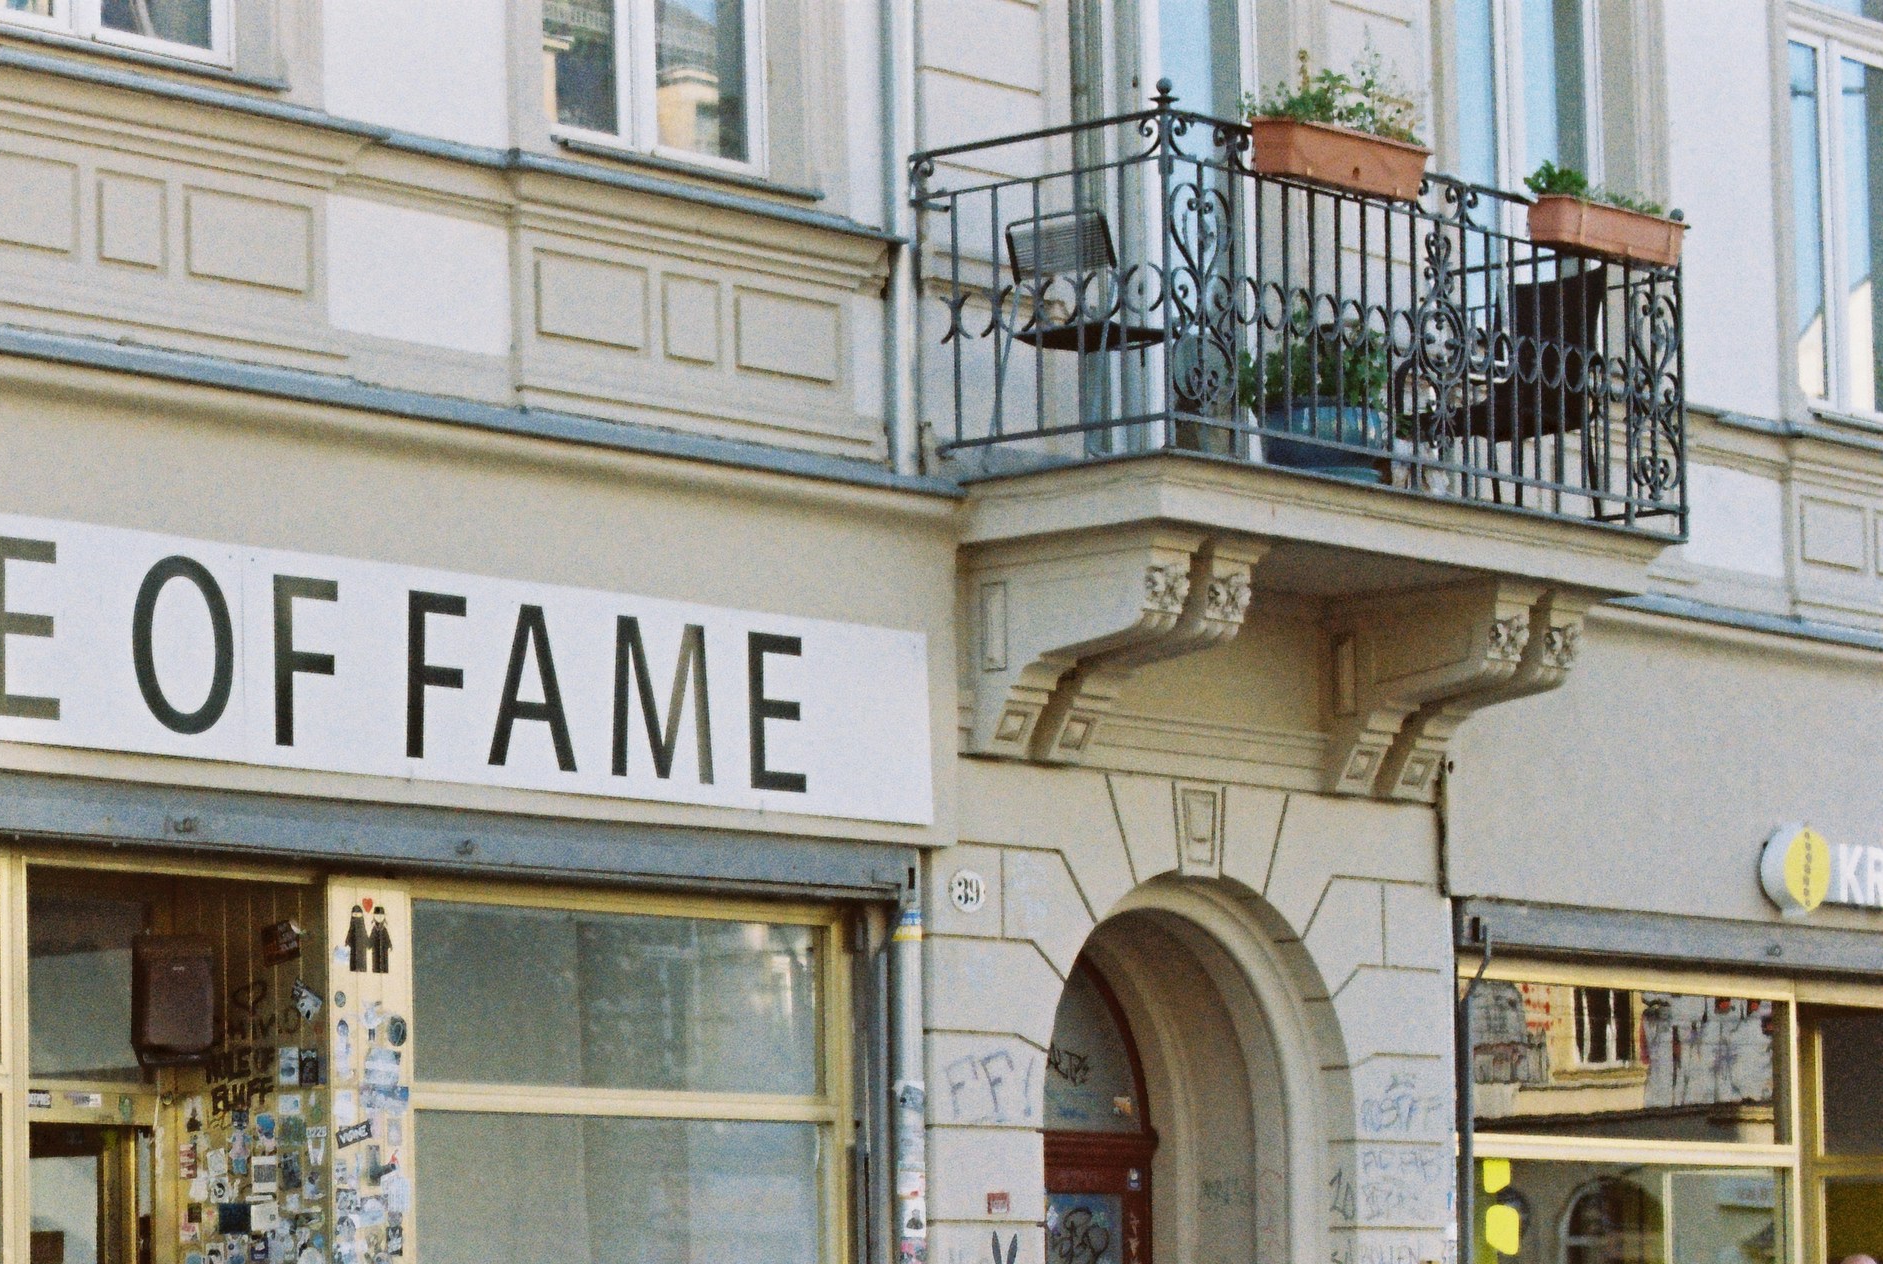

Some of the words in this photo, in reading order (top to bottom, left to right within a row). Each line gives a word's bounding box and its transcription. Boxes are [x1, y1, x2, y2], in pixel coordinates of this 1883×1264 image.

[132, 555, 338, 747] OF
[406, 589, 808, 793] FAME
[957, 878, 980, 904] 39
